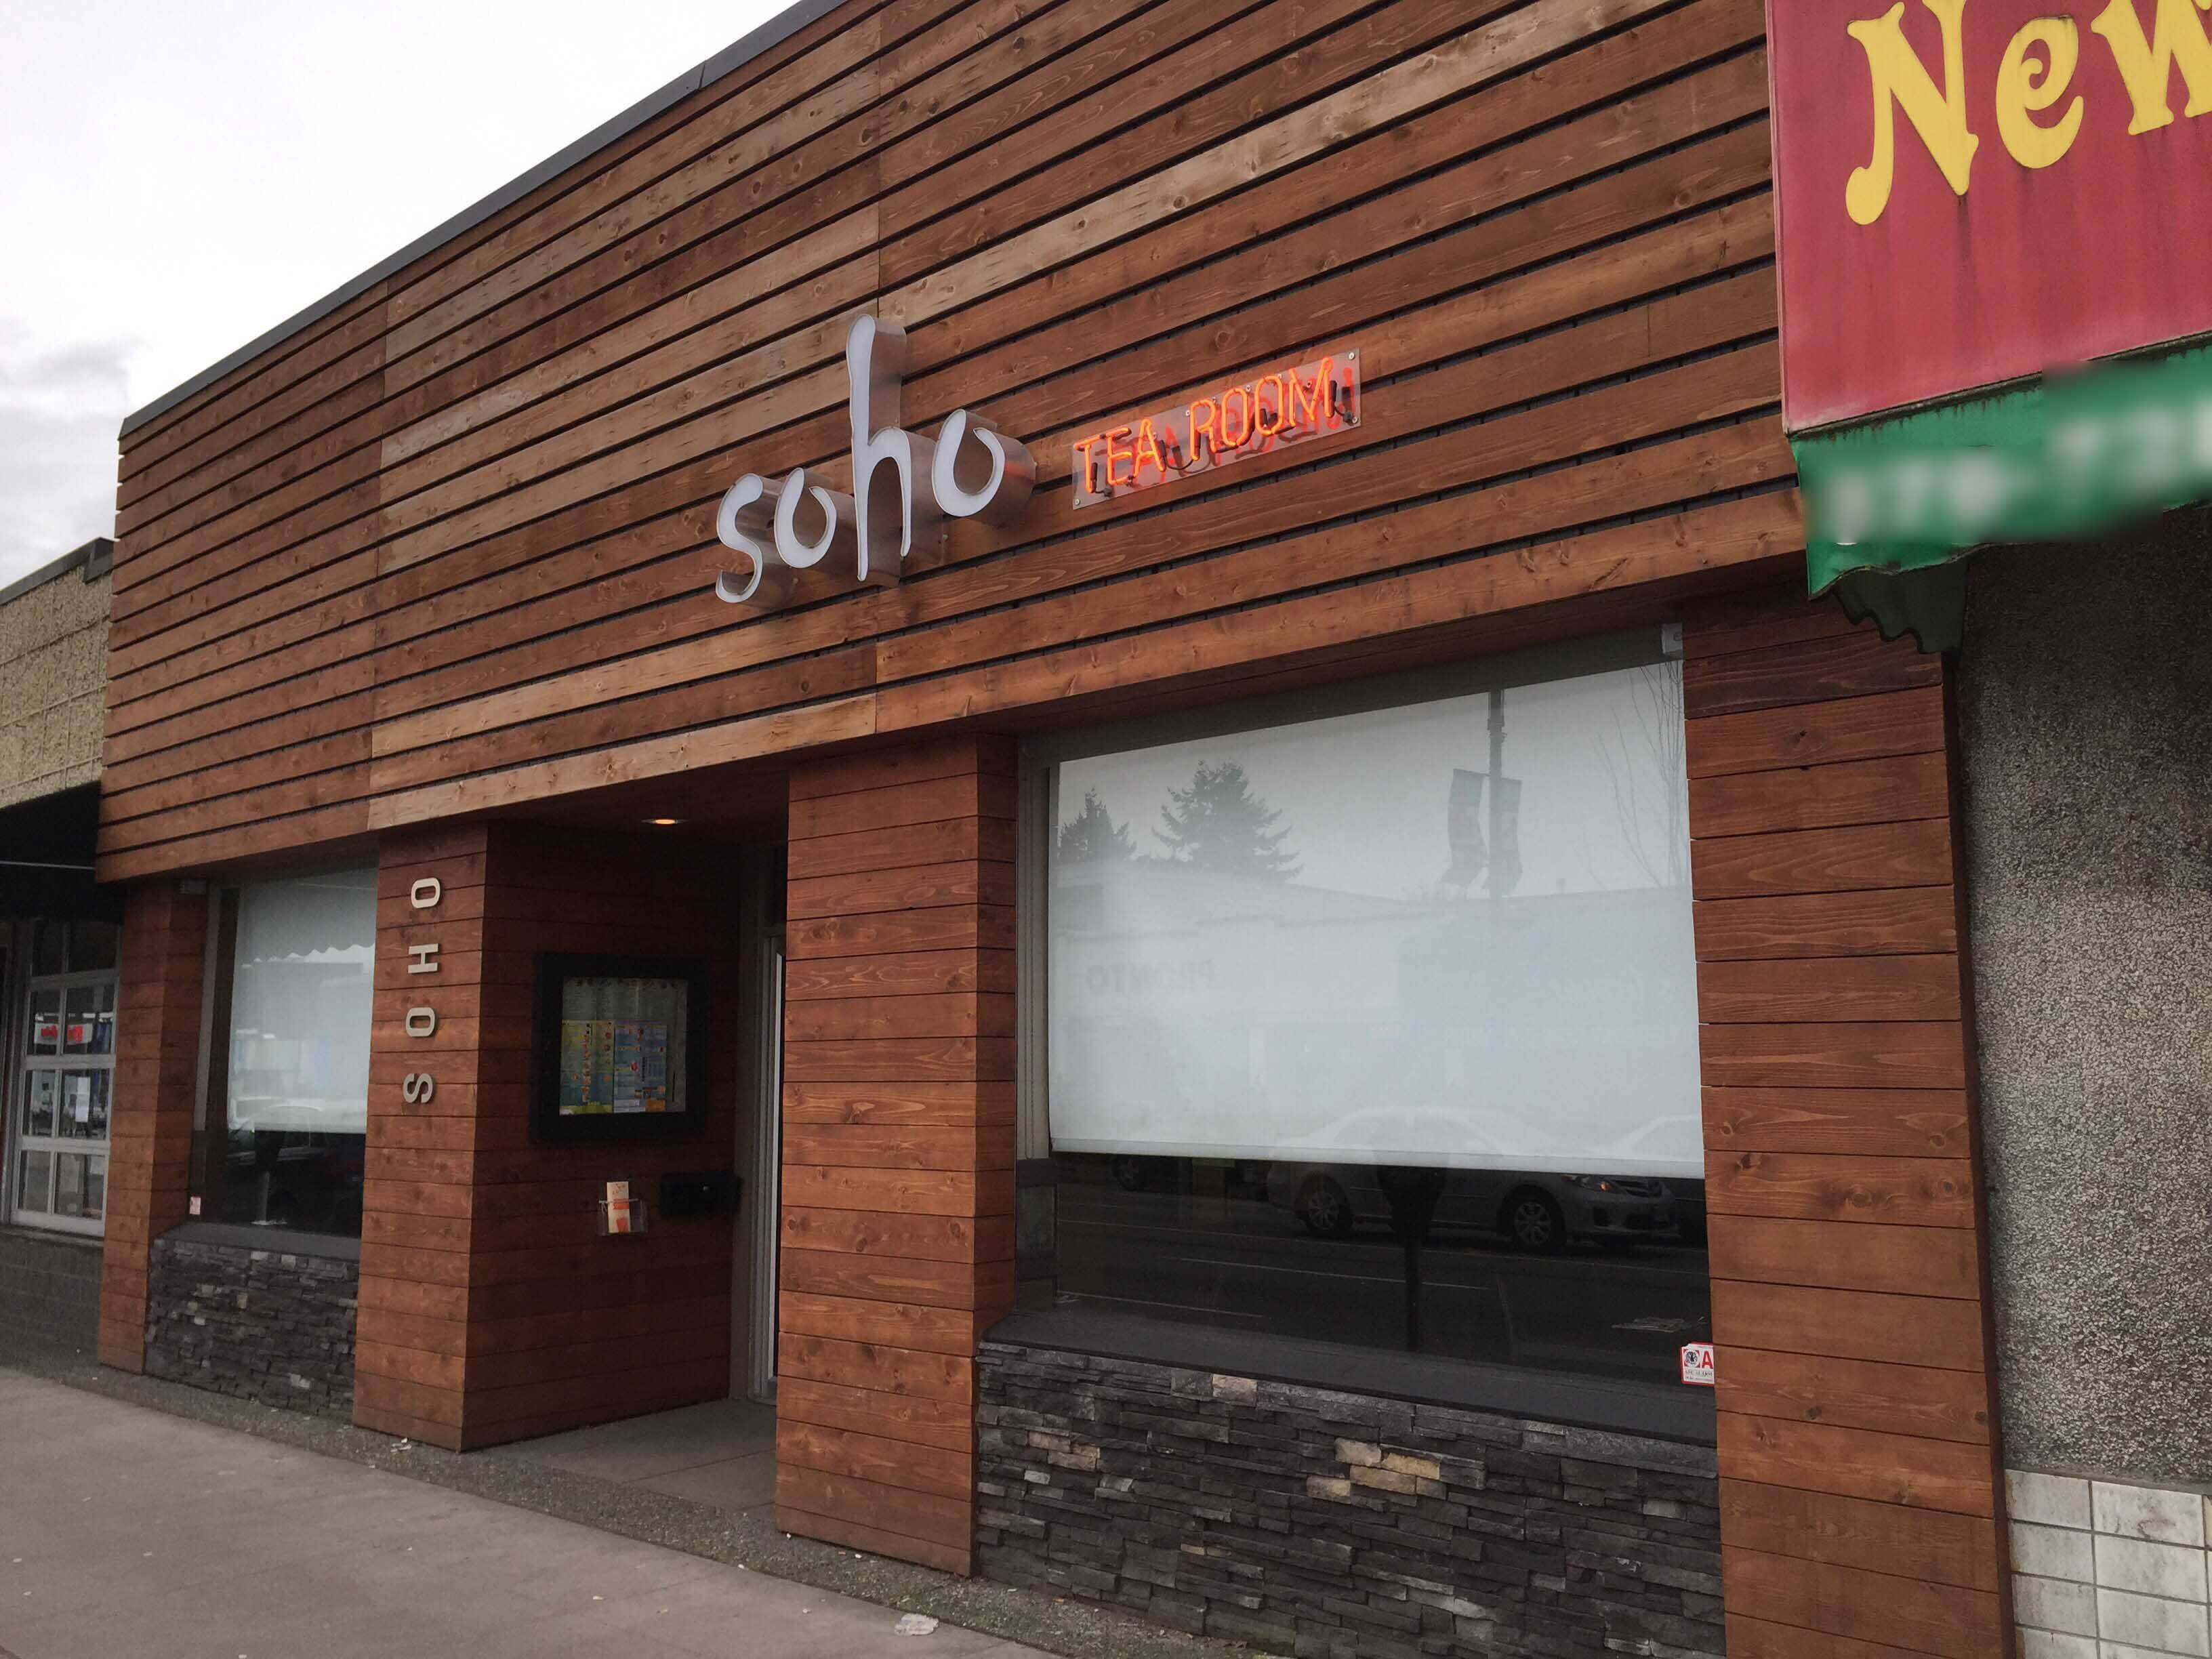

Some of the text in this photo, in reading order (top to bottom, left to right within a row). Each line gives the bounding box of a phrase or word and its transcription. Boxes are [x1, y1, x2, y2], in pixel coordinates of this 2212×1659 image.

[1846, 0, 2212, 224] New
[715, 313, 1008, 604] soho
[1073, 356, 1334, 493] TEA ROOM
[403, 878, 441, 1104] SOHO
